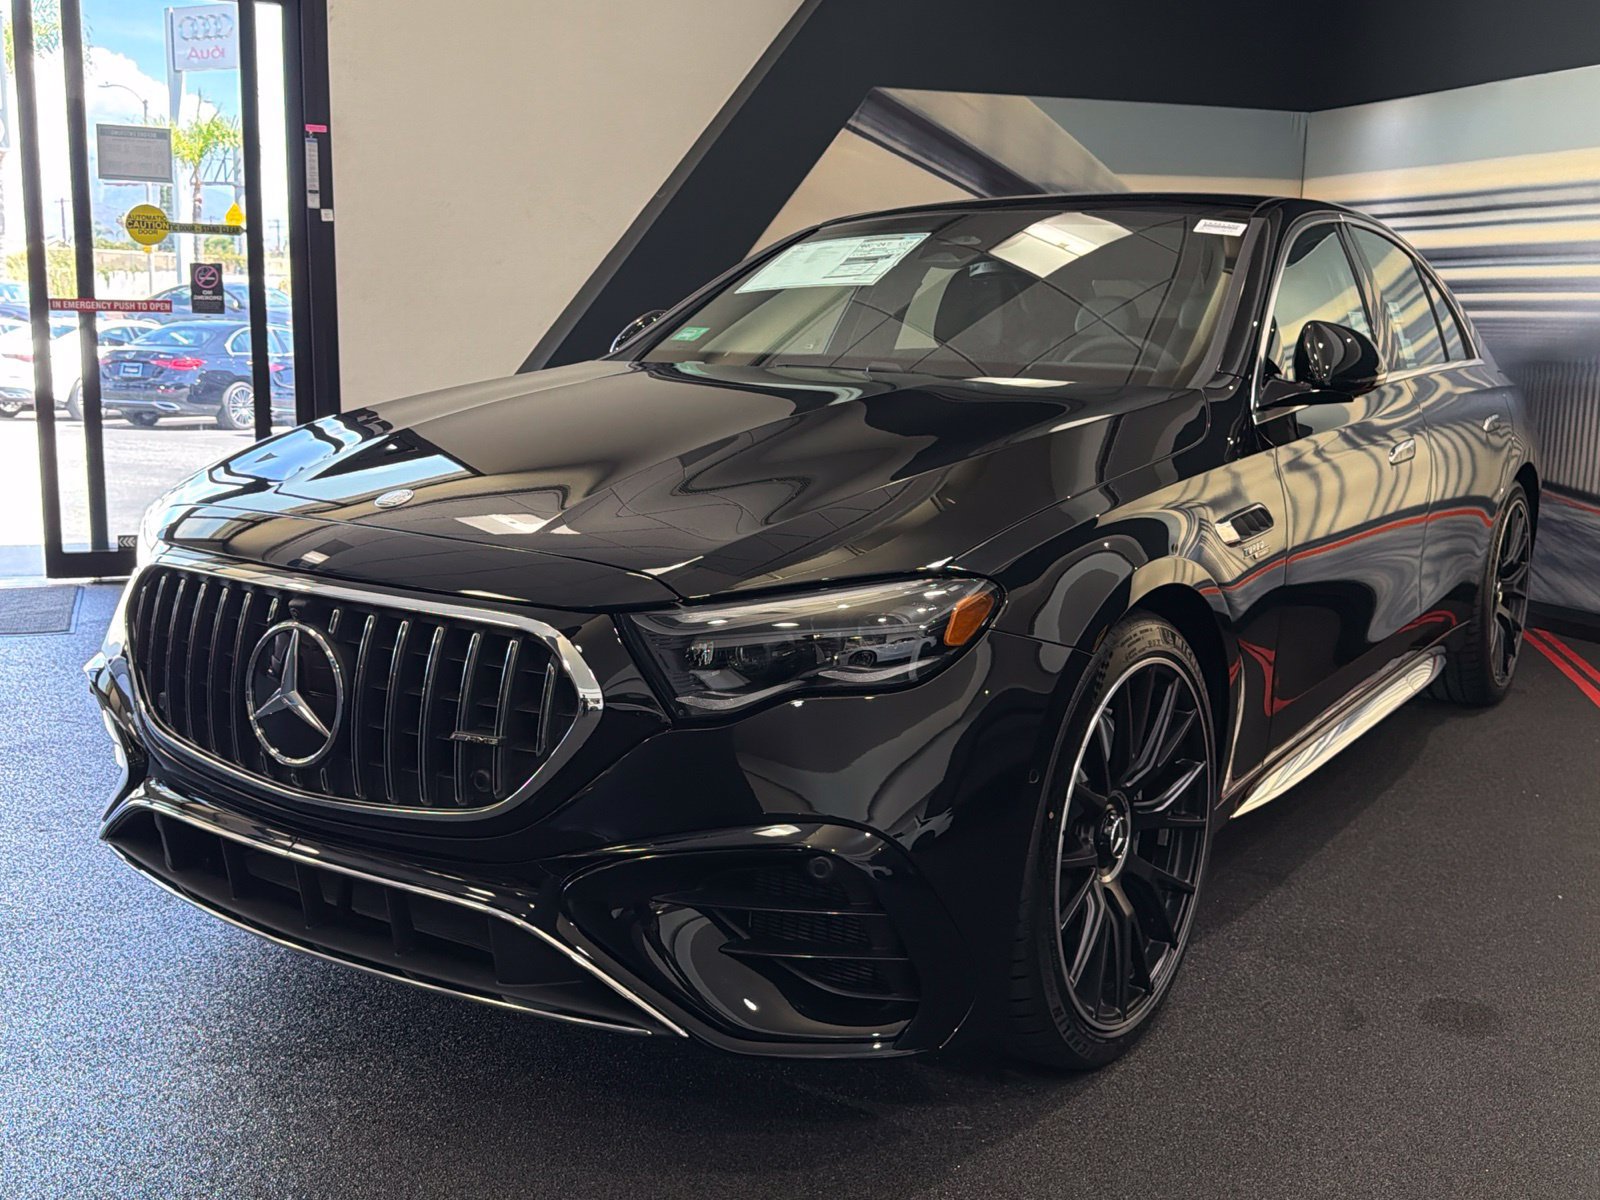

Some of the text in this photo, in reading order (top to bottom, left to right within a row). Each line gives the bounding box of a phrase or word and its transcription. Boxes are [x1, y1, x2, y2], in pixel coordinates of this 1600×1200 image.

[187, 46, 225, 60] Audi
[127, 220, 169, 229] CAUTION
[52, 301, 171, 310] IN EMERGENCY PUSH TO OPEN
